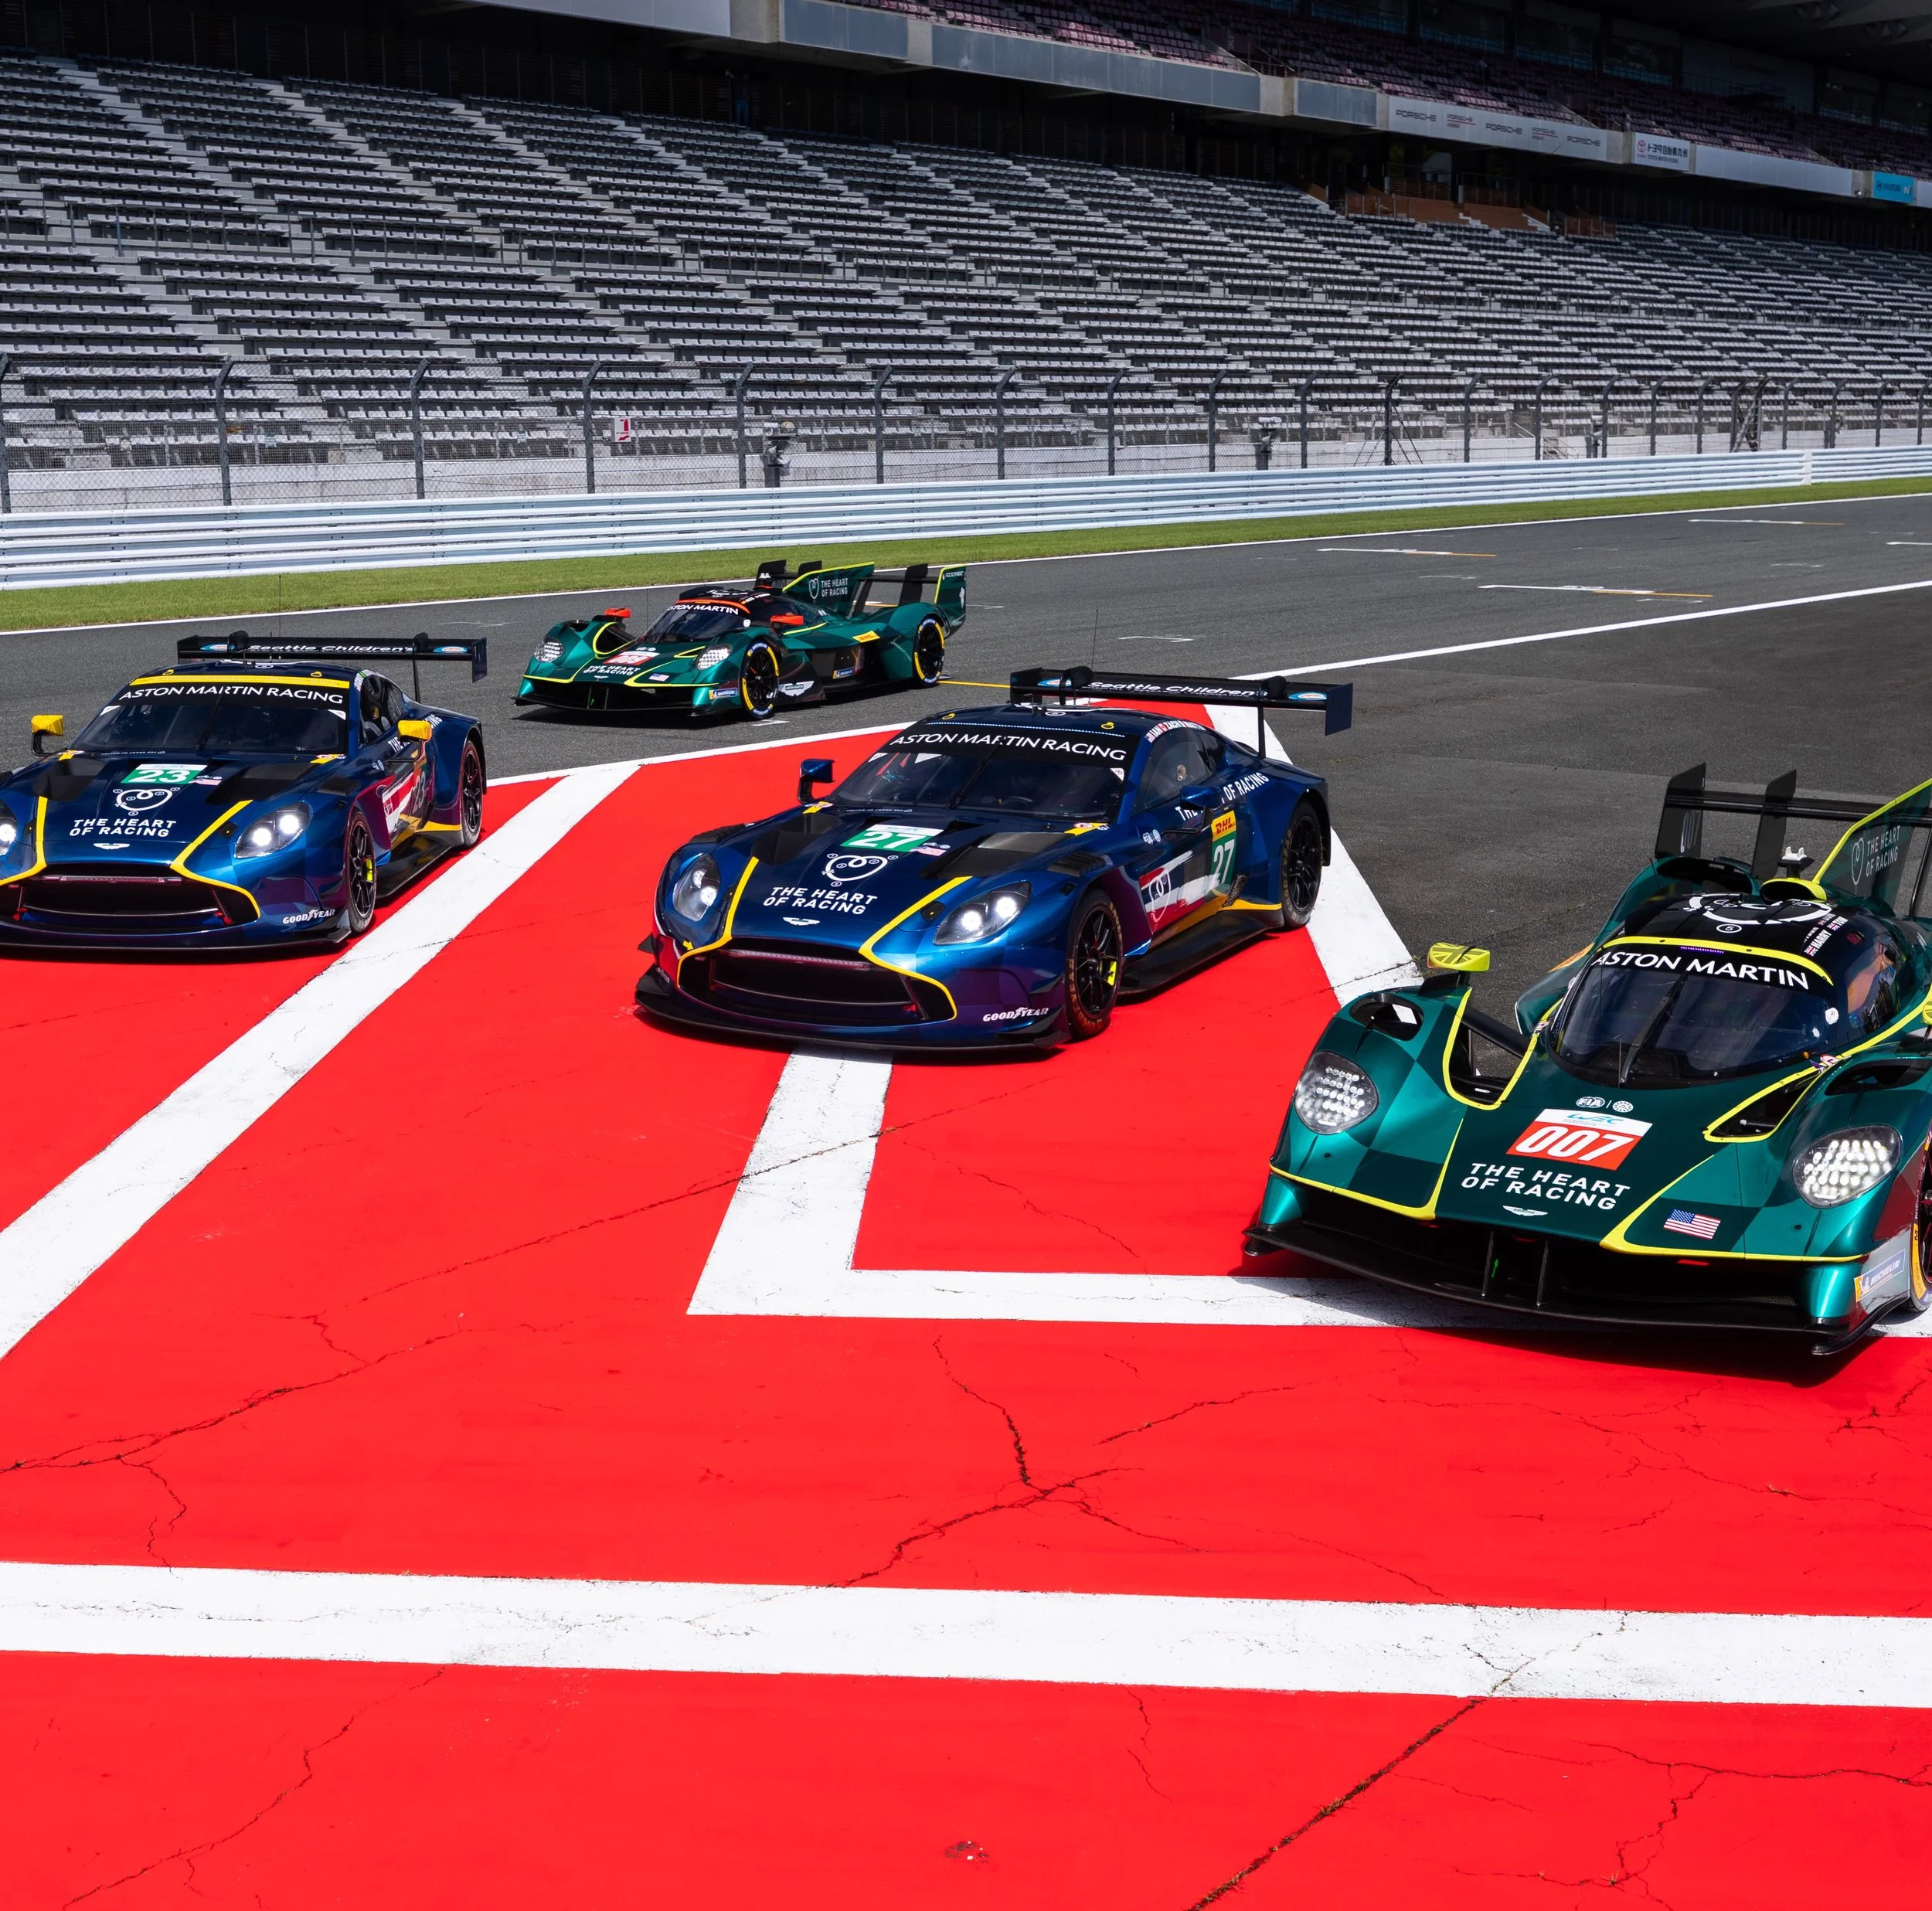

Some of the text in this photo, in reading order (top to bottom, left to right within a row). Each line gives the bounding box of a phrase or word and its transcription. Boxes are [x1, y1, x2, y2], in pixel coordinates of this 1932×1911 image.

[1396, 109, 1437, 122] PORSCHE
[1447, 114, 1474, 122] PORSCHE
[1485, 123, 1523, 135] PORSCHE
[1566, 135, 1601, 147] PORSCHE
[829, 587, 849, 596] RACING
[832, 578, 849, 587] HEART
[692, 604, 739, 615] MARTIN
[1087, 682, 1161, 690] Seattle
[119, 686, 344, 705] ASTON MARTIN RACING
[889, 733, 1127, 761] ASTON MARTIN RACING
[128, 770, 190, 783] 23
[1223, 772, 1270, 801] OF RACING
[69, 827, 169, 838] OF RACING
[74, 818, 176, 829] THE HEART
[1215, 817, 1234, 835] DHL
[848, 831, 927, 848] 27
[1866, 825, 1901, 852] THE HEART
[1213, 838, 1236, 885] 27
[1866, 846, 1899, 878] OF RACING
[770, 887, 878, 906] THE HEART
[763, 897, 866, 915] OF RACING
[282, 909, 335, 924] GOODYEAR
[1810, 929, 1832, 950] HARRY
[1590, 951, 1809, 990] ASTON MARTIN
[982, 1007, 1049, 1022] GOODYEAR
[1515, 1126, 1634, 1161] 007
[1469, 1163, 1631, 1197] THE HEART
[1461, 1177, 1617, 1210] OF RACING
[1870, 1259, 1900, 1285] MICHELIN
